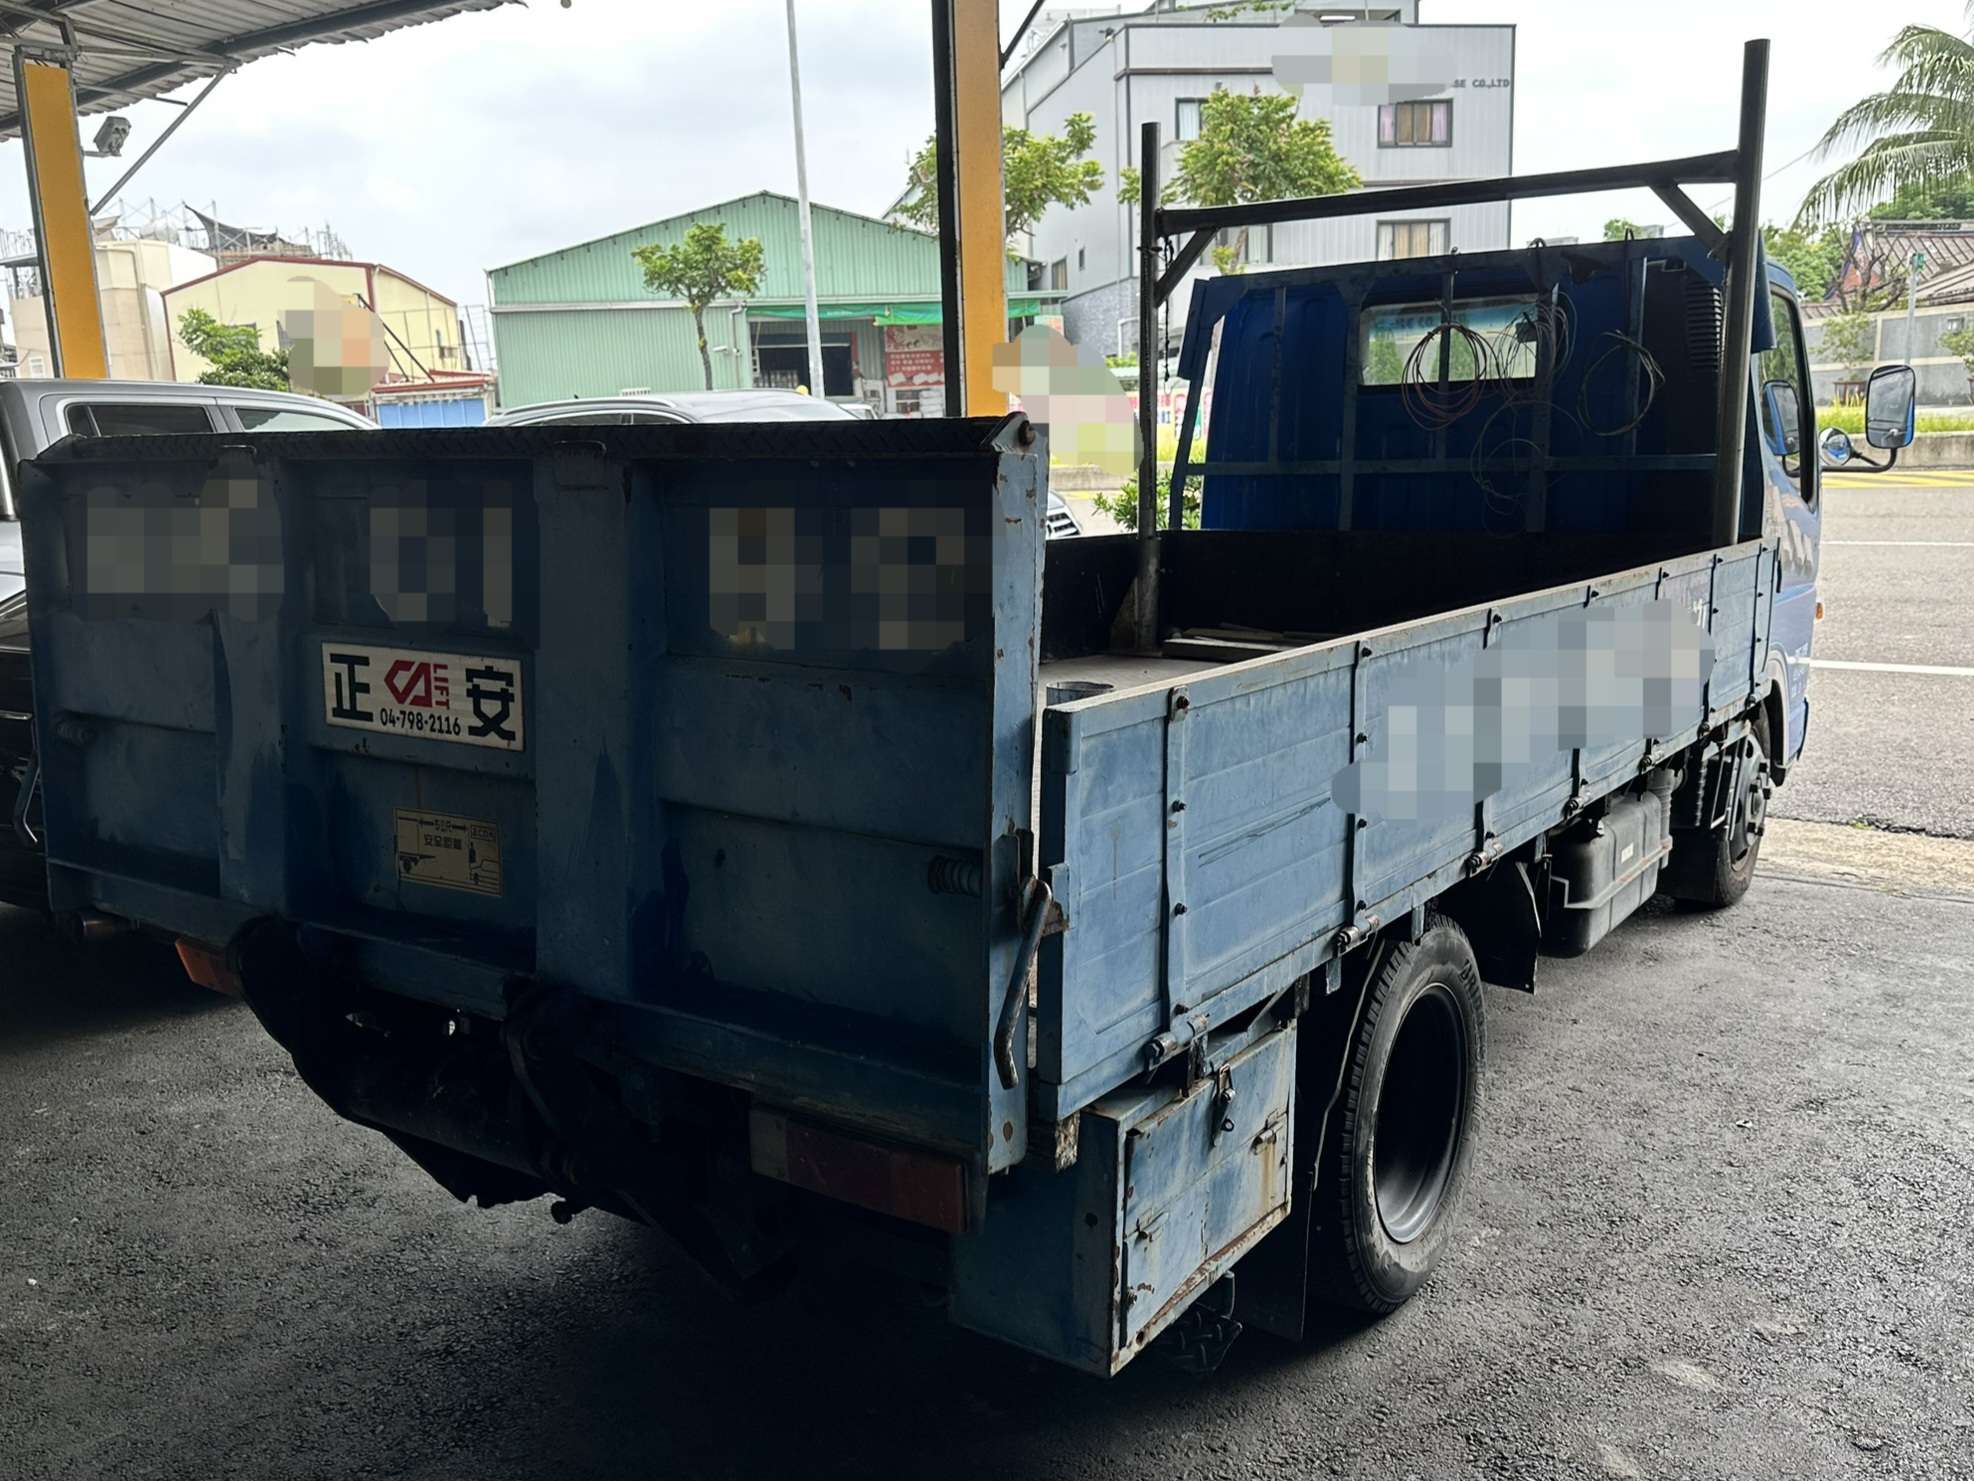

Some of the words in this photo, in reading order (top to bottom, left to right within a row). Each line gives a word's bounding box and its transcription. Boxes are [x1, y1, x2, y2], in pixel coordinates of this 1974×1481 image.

[330, 653, 373, 721] 正
[433, 663, 450, 710] LIFT
[466, 666, 516, 741] 安
